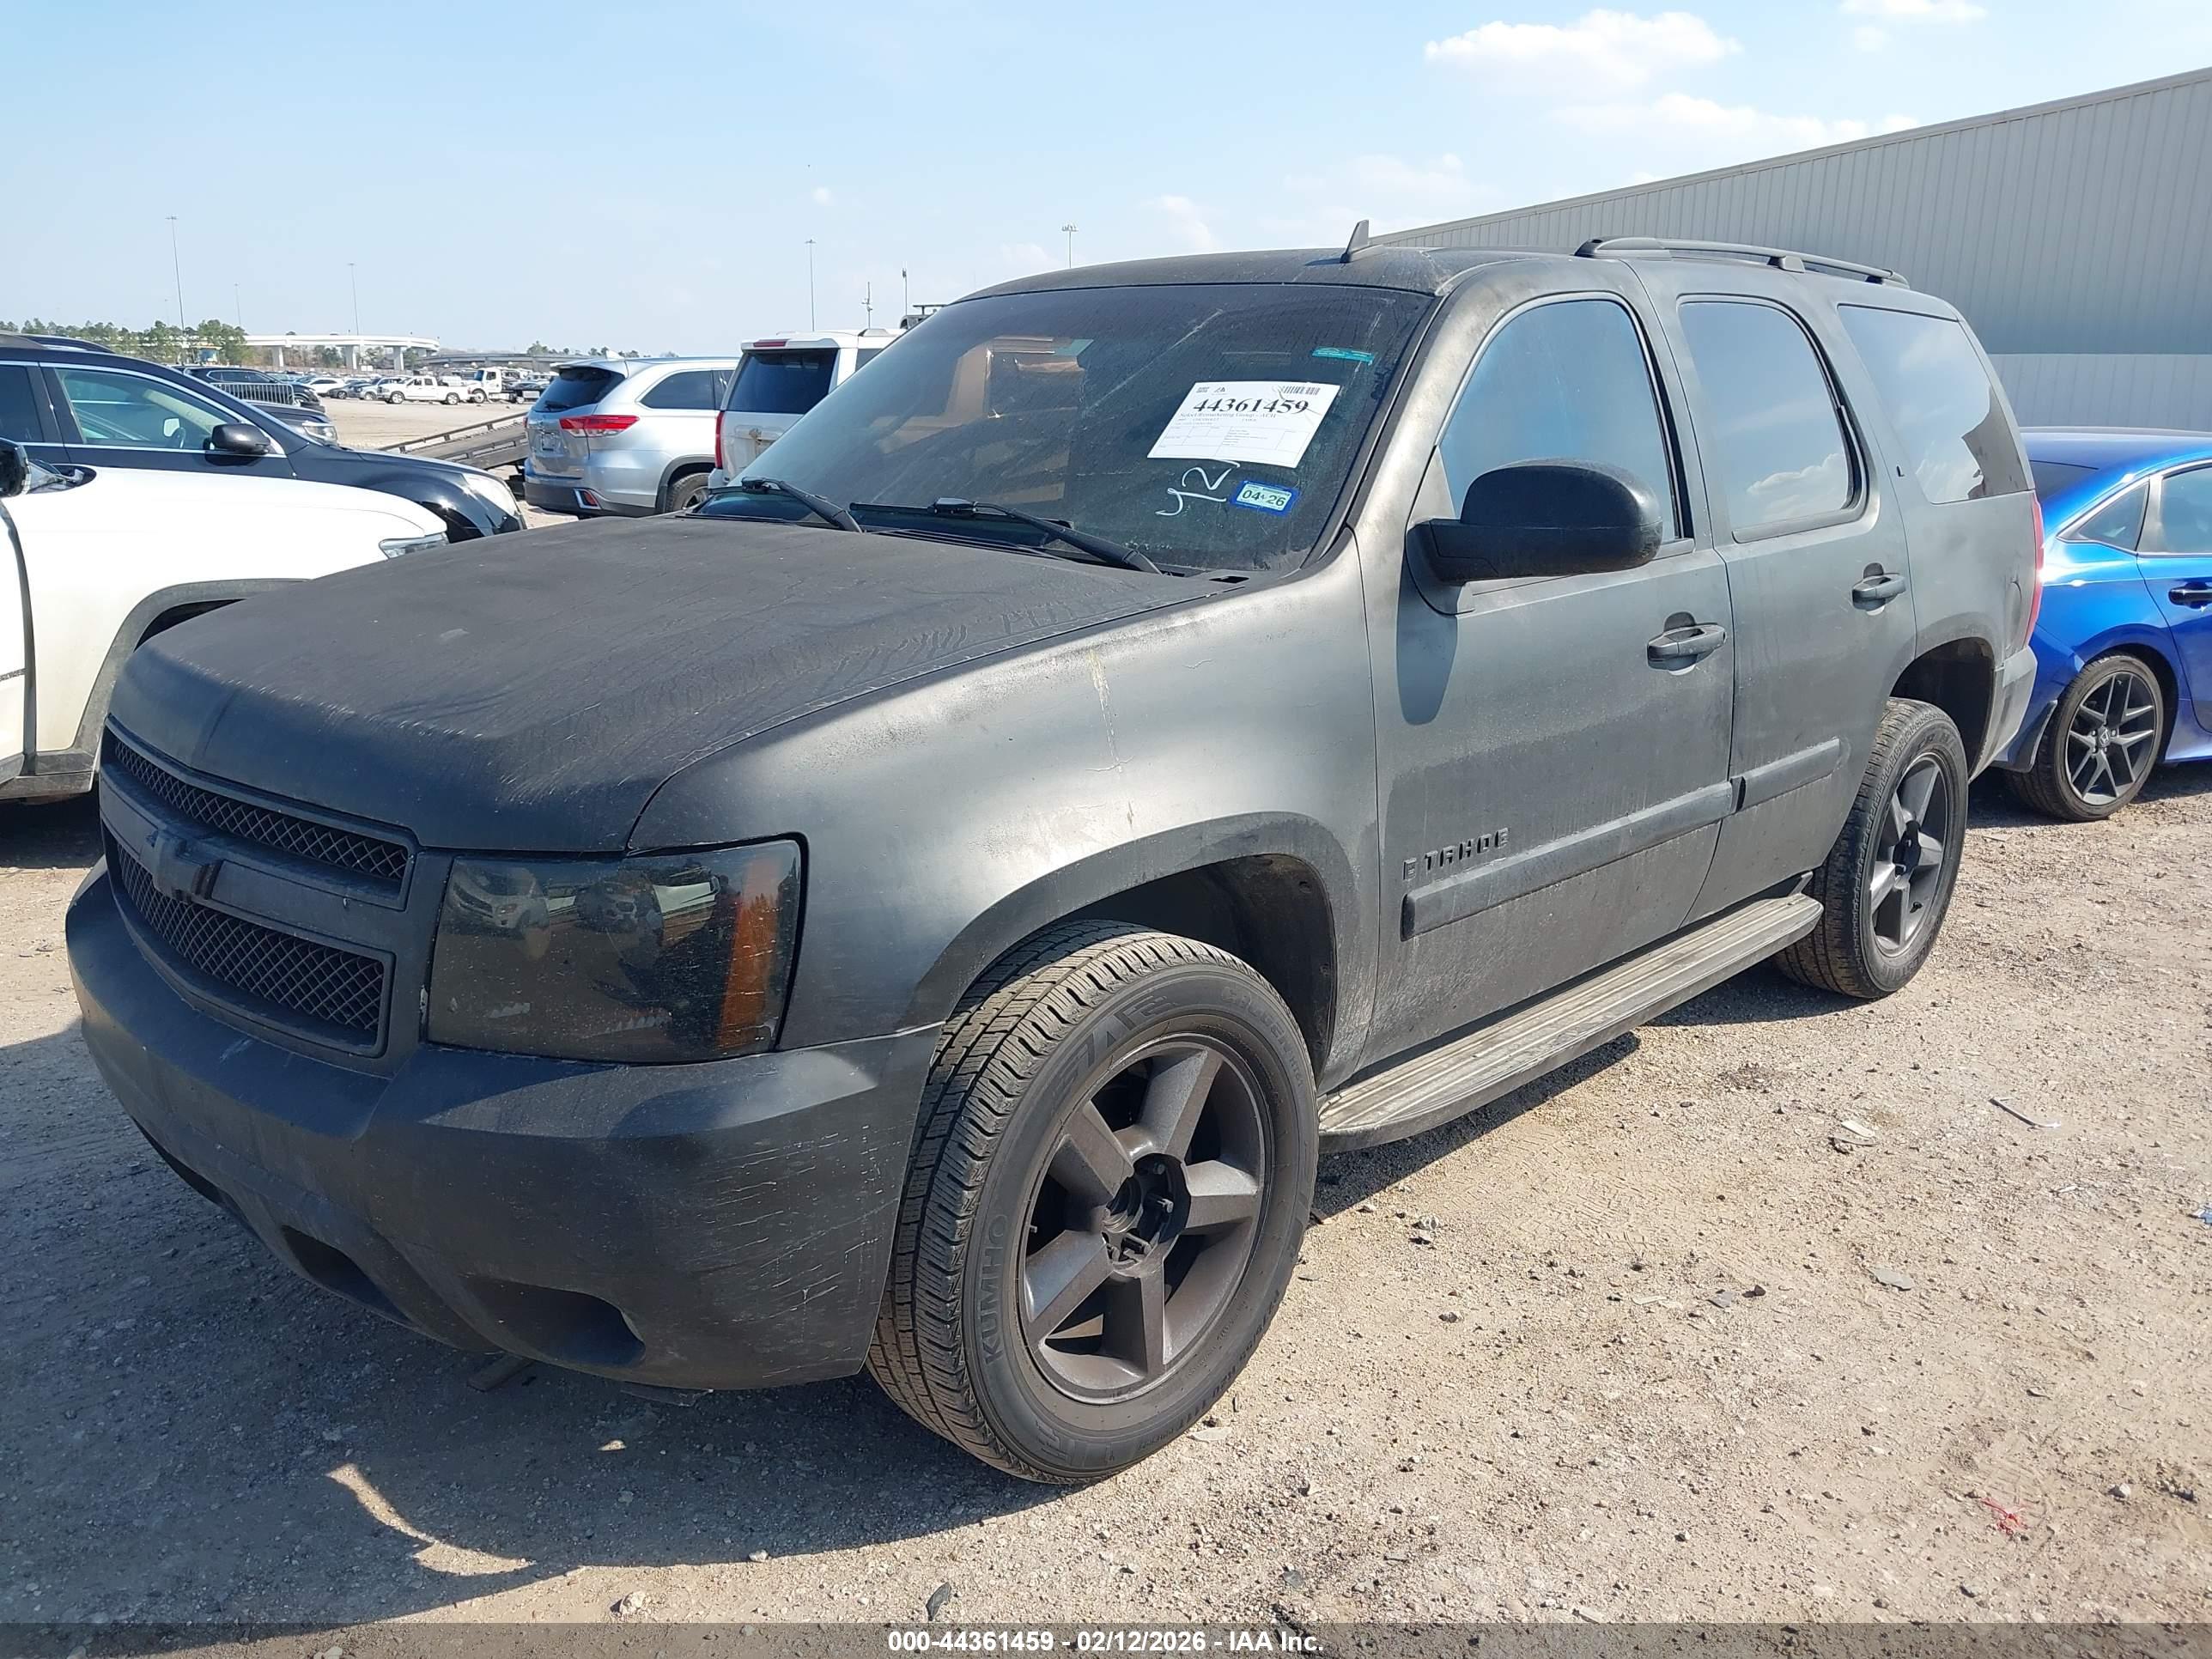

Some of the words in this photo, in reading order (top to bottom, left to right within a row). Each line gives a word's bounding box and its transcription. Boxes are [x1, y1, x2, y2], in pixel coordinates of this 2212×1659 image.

[1193, 398, 1309, 415] 44361459
[1242, 489, 1261, 501] 04
[1267, 495, 1286, 507] 26
[1425, 829, 1509, 872] TAHOE
[979, 1214, 1008, 1364] KUMHO
